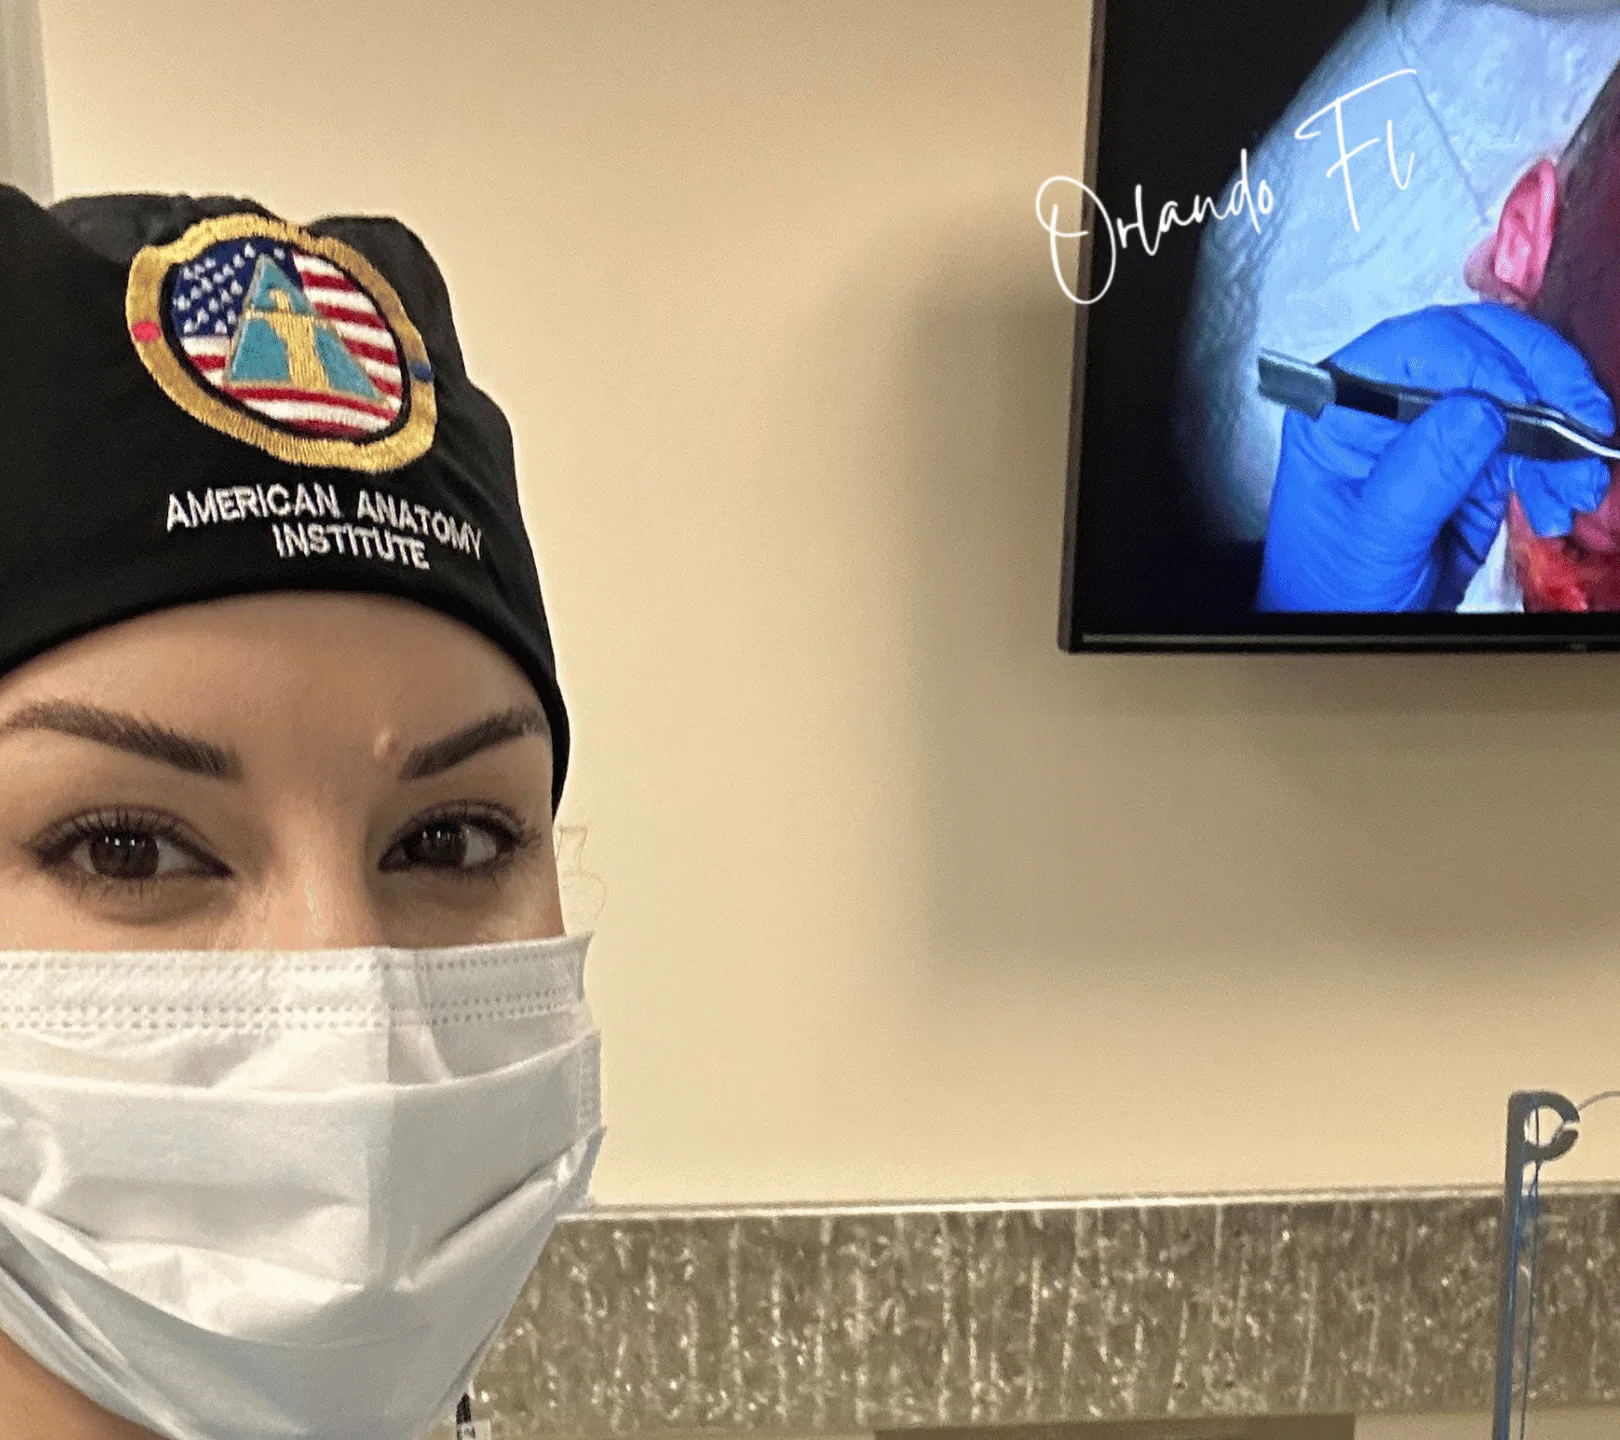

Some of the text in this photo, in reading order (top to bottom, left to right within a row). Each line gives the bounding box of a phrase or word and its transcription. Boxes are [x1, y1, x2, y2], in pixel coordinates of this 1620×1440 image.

[166, 483, 484, 561] AMERICAN ANATOMY
[271, 522, 430, 571] INSTITUTE
